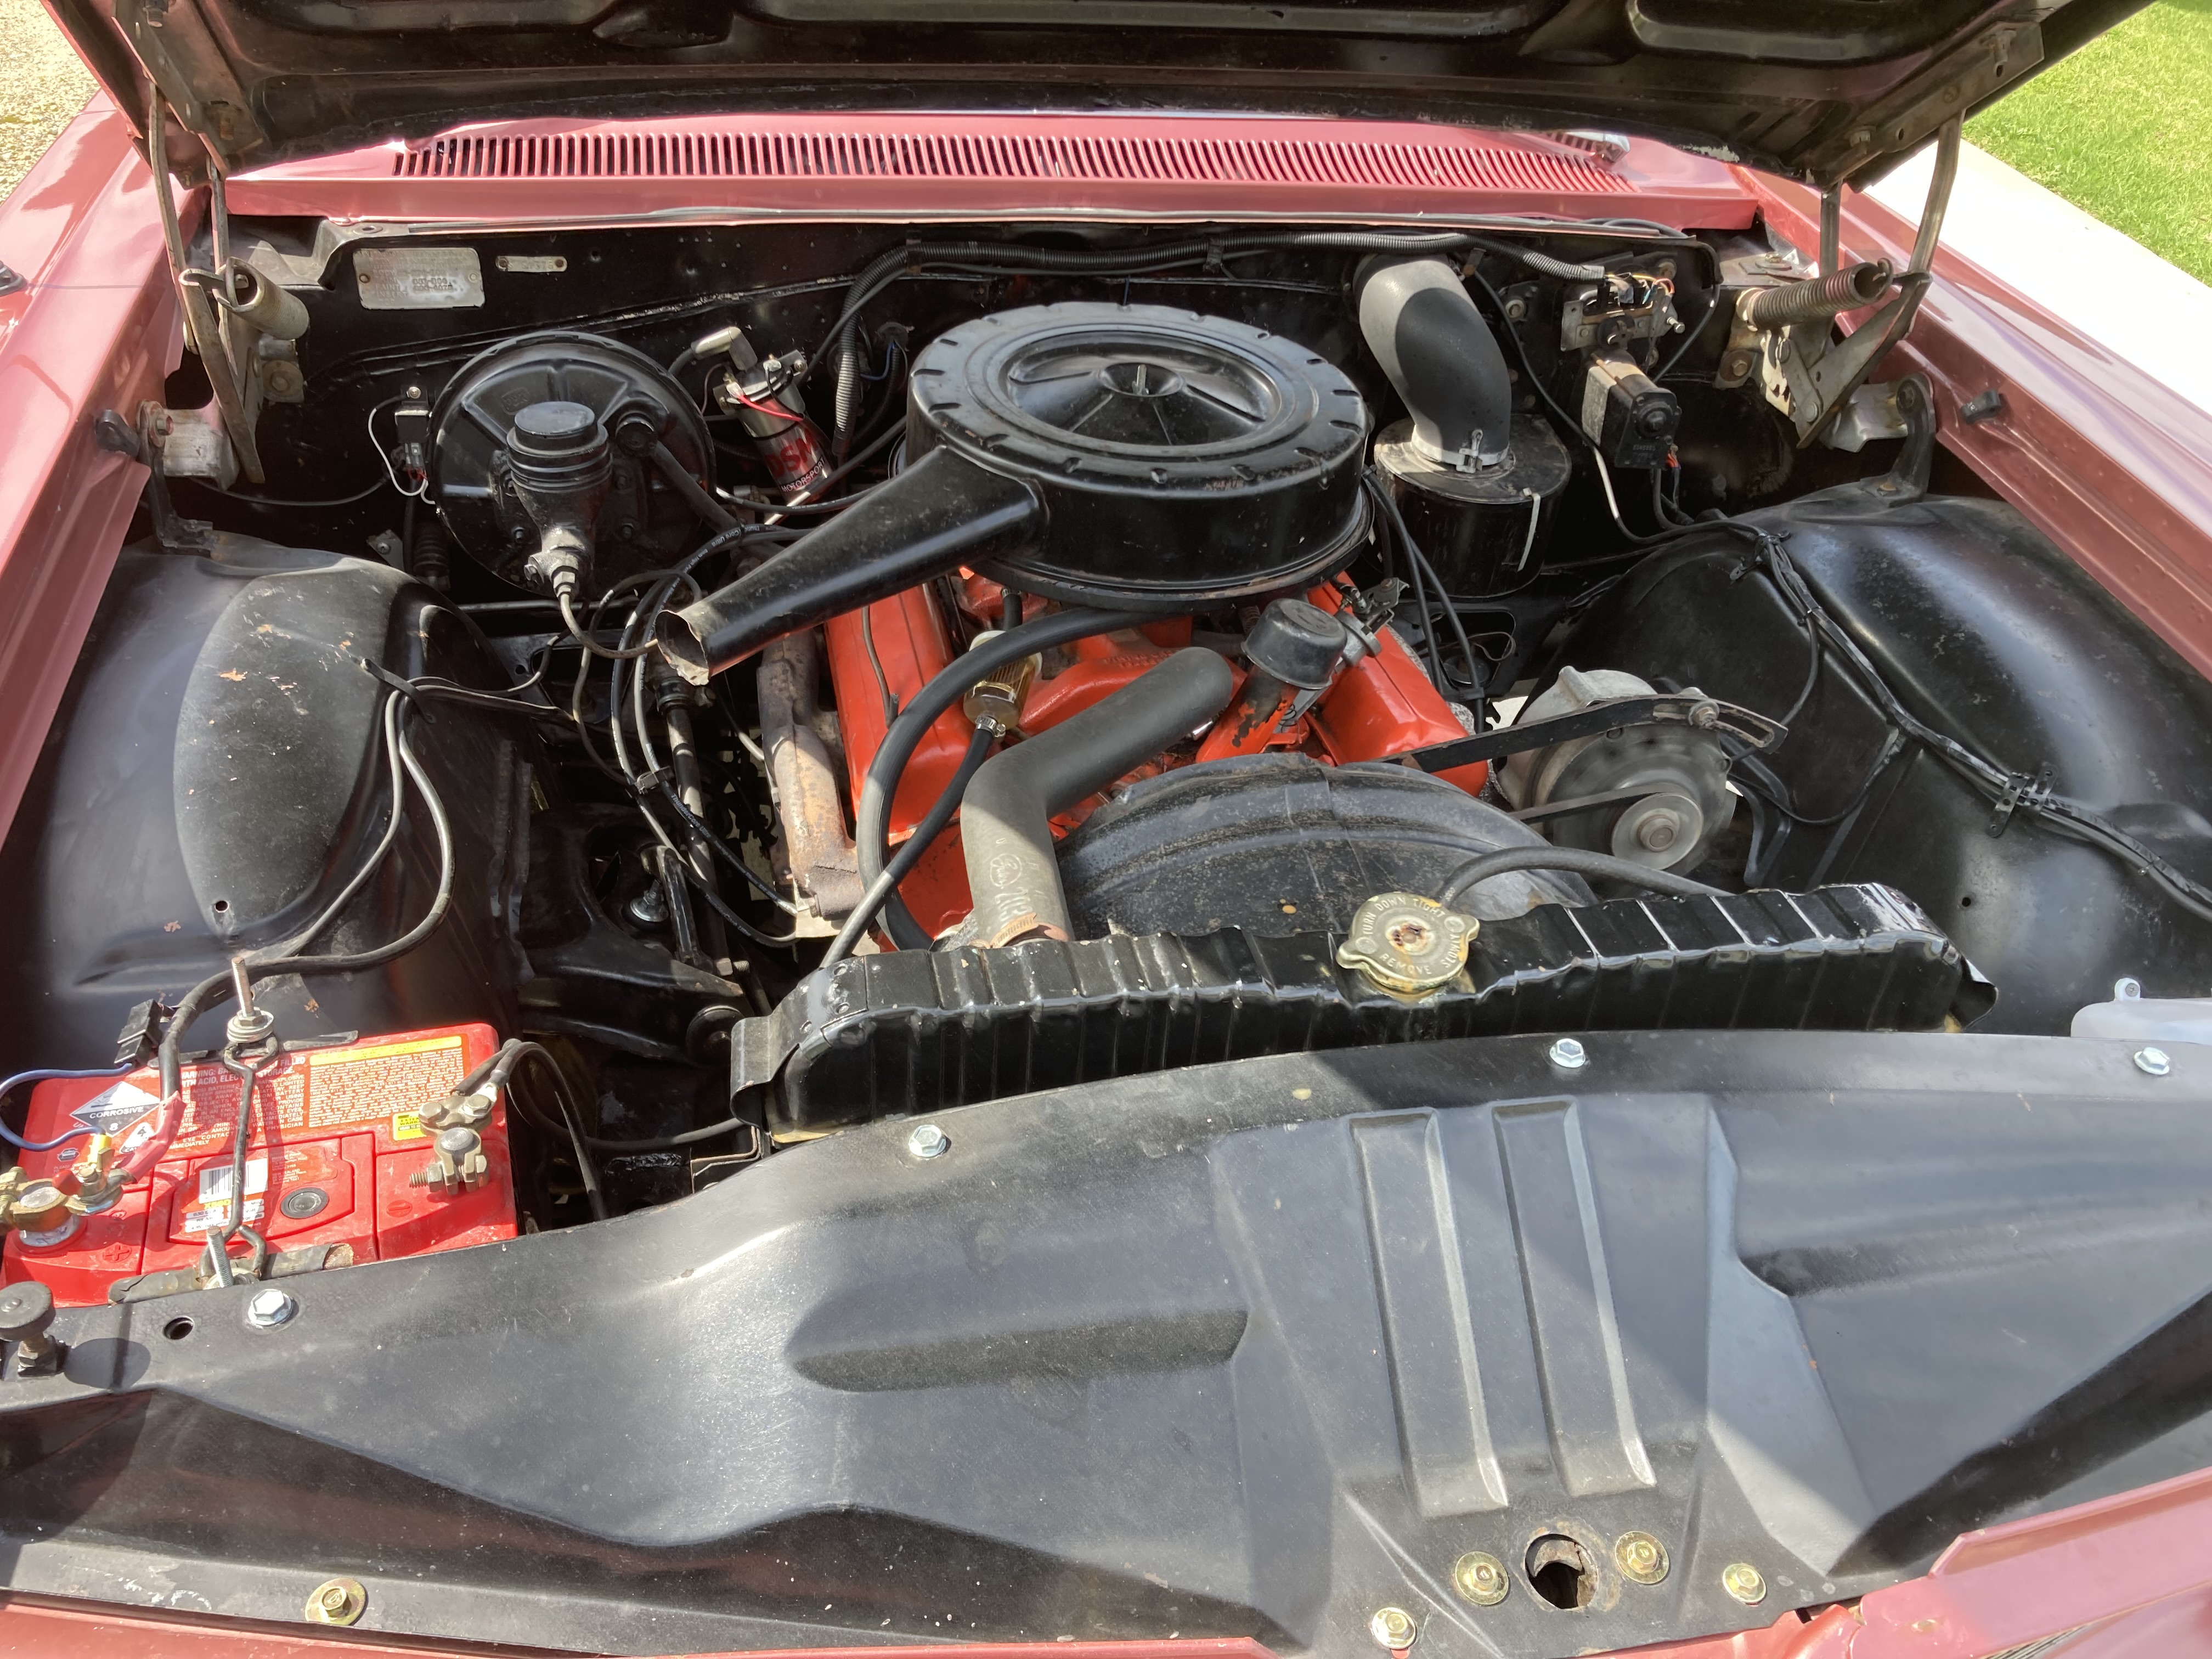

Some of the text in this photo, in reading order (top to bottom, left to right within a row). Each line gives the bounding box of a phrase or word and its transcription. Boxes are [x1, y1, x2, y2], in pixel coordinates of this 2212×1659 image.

[781, 456, 826, 493] MOTORSPORT
[1362, 896, 1446, 935] TURN DOWN TIGHT
[1441, 933, 1462, 969] SLOWLY
[1379, 953, 1432, 975] REMOVE
[198, 1076, 218, 1086] ACID,
[275, 1088, 304, 1096] BATTERY
[89, 1106, 145, 1119] CORROSIVE
[109, 1122, 119, 1131] 8
[201, 1132, 235, 1140] CONTACT
[267, 1121, 303, 1131] PHYSICIAN
